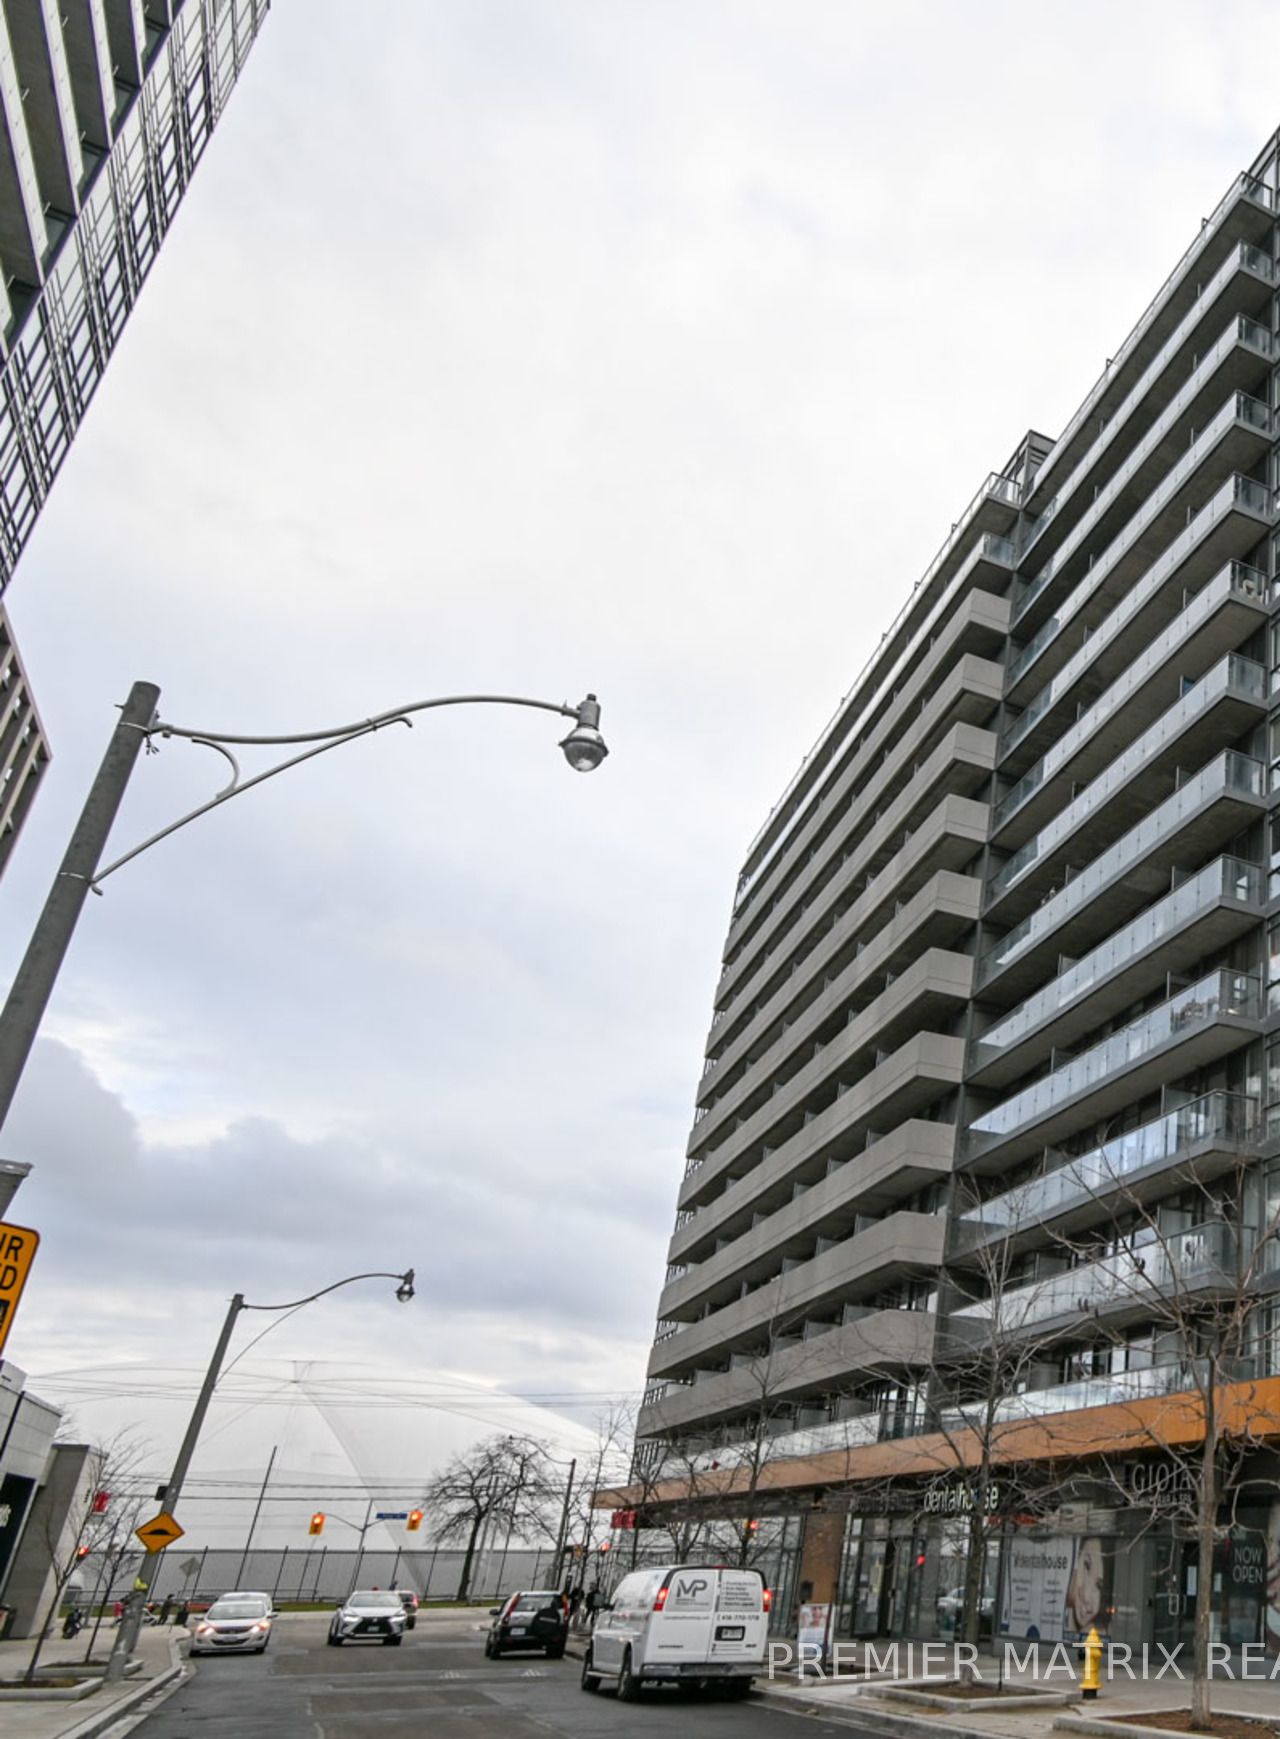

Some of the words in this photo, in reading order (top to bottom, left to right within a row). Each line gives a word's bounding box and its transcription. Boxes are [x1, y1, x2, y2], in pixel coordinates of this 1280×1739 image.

[0, 1265, 17, 1290] D
[1234, 1547, 1263, 1565] NOW
[1232, 1565, 1263, 1583] OPEN
